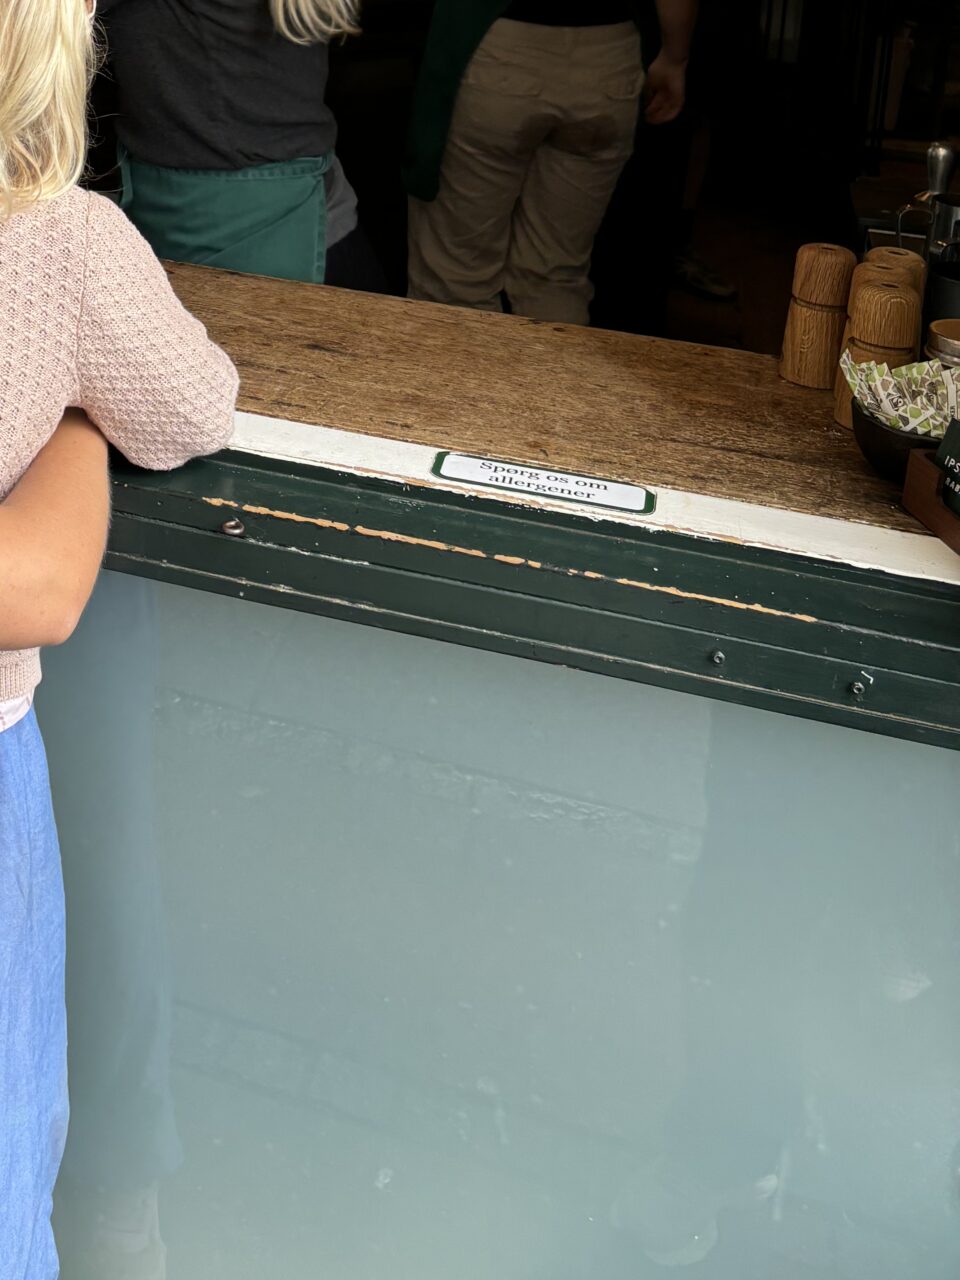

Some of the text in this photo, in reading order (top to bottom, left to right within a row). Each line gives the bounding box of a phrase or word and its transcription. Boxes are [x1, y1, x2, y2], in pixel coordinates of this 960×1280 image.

[479, 461, 608, 491] Spørg os om
[488, 473, 595, 499] allergener
